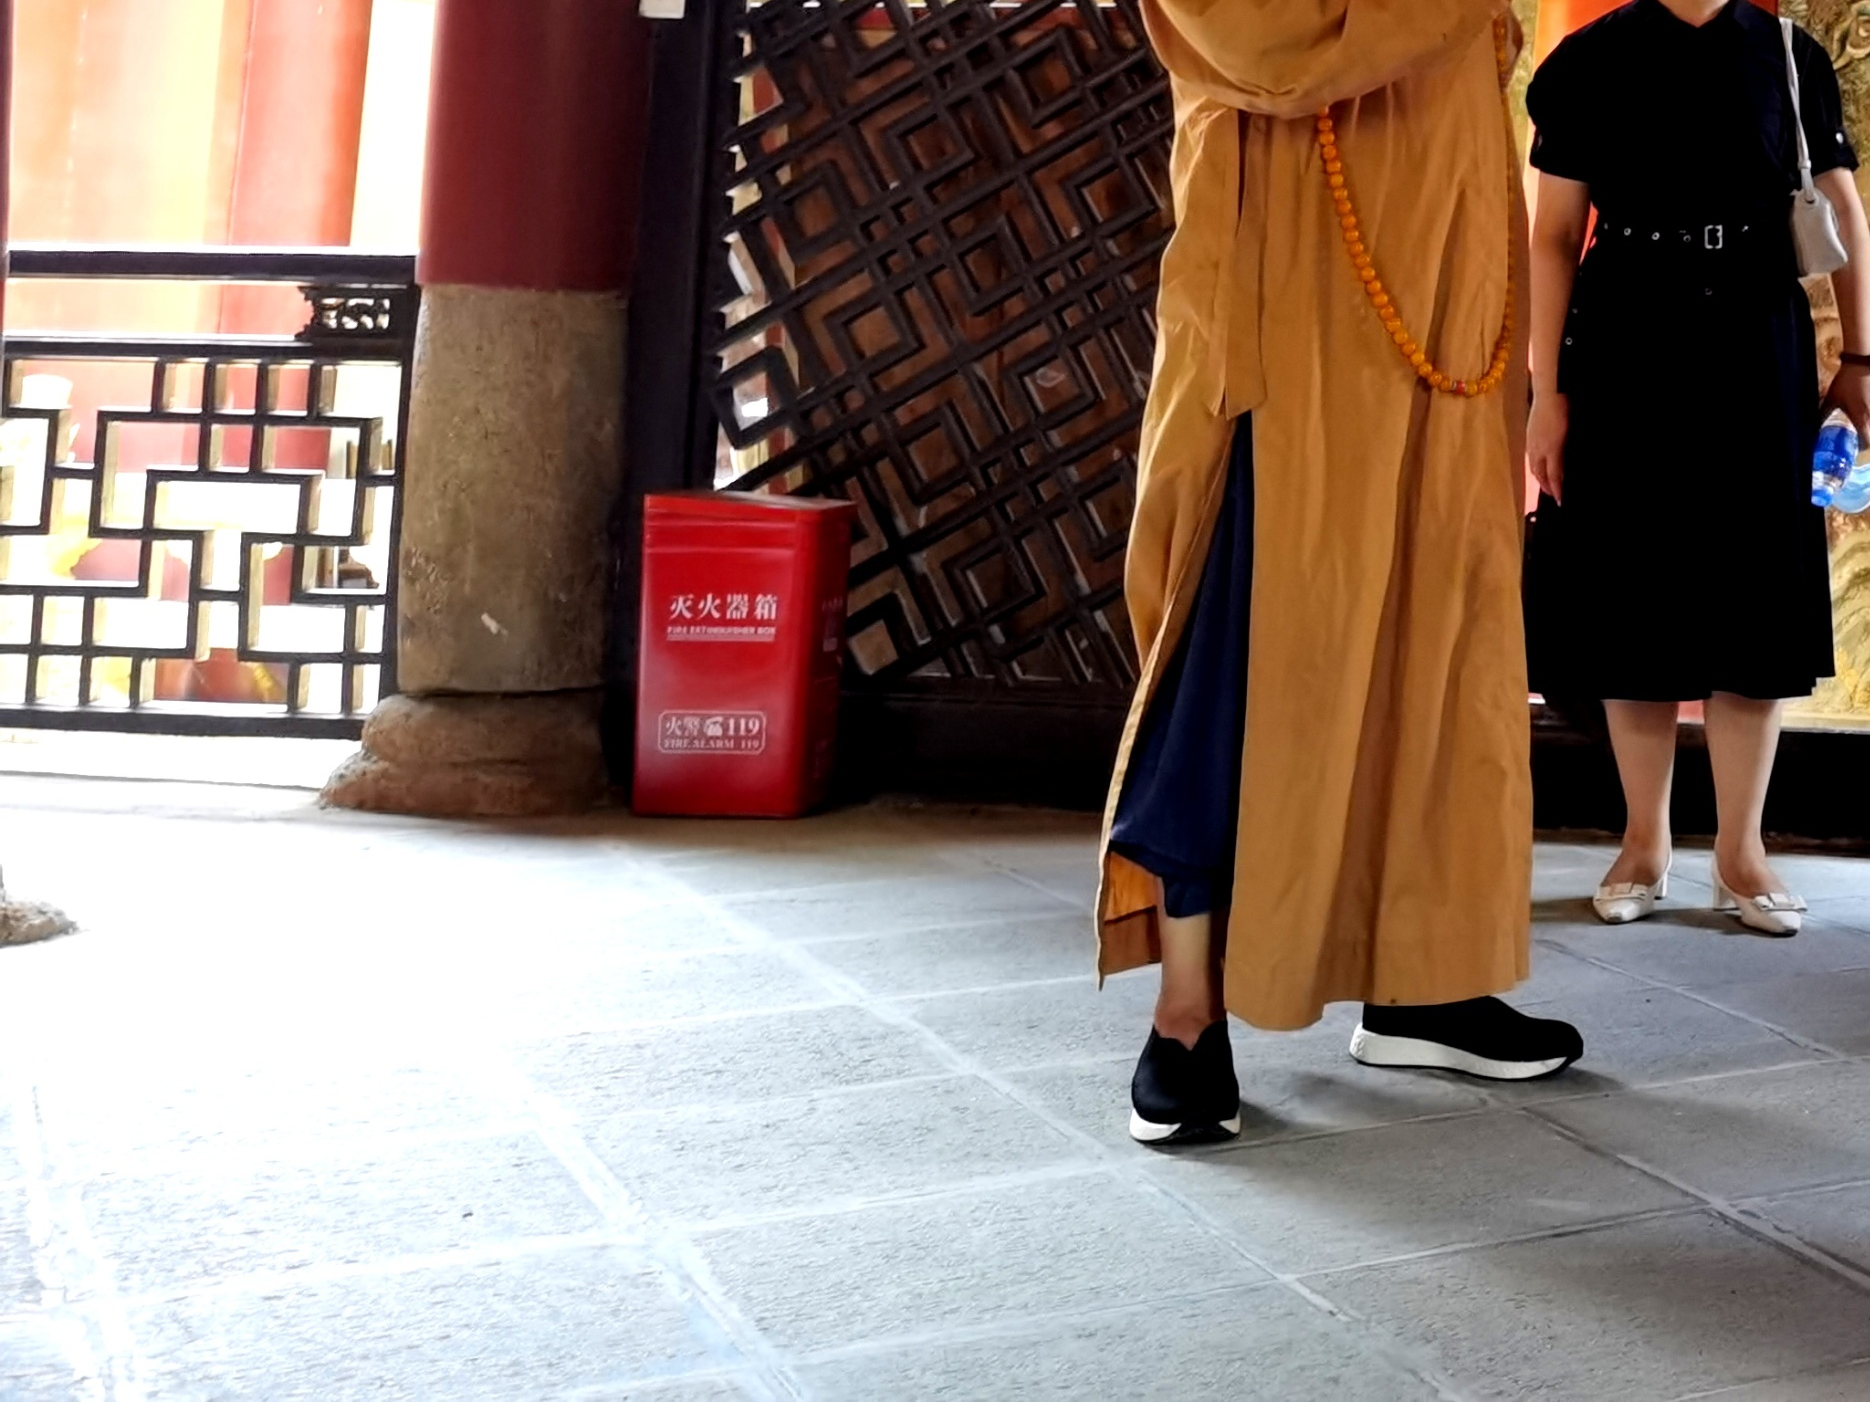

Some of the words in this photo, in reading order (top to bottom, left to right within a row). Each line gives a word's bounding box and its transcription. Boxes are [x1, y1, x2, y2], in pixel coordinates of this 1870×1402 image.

[669, 593, 778, 620] 灭火器箱
[728, 717, 760, 737] 119
